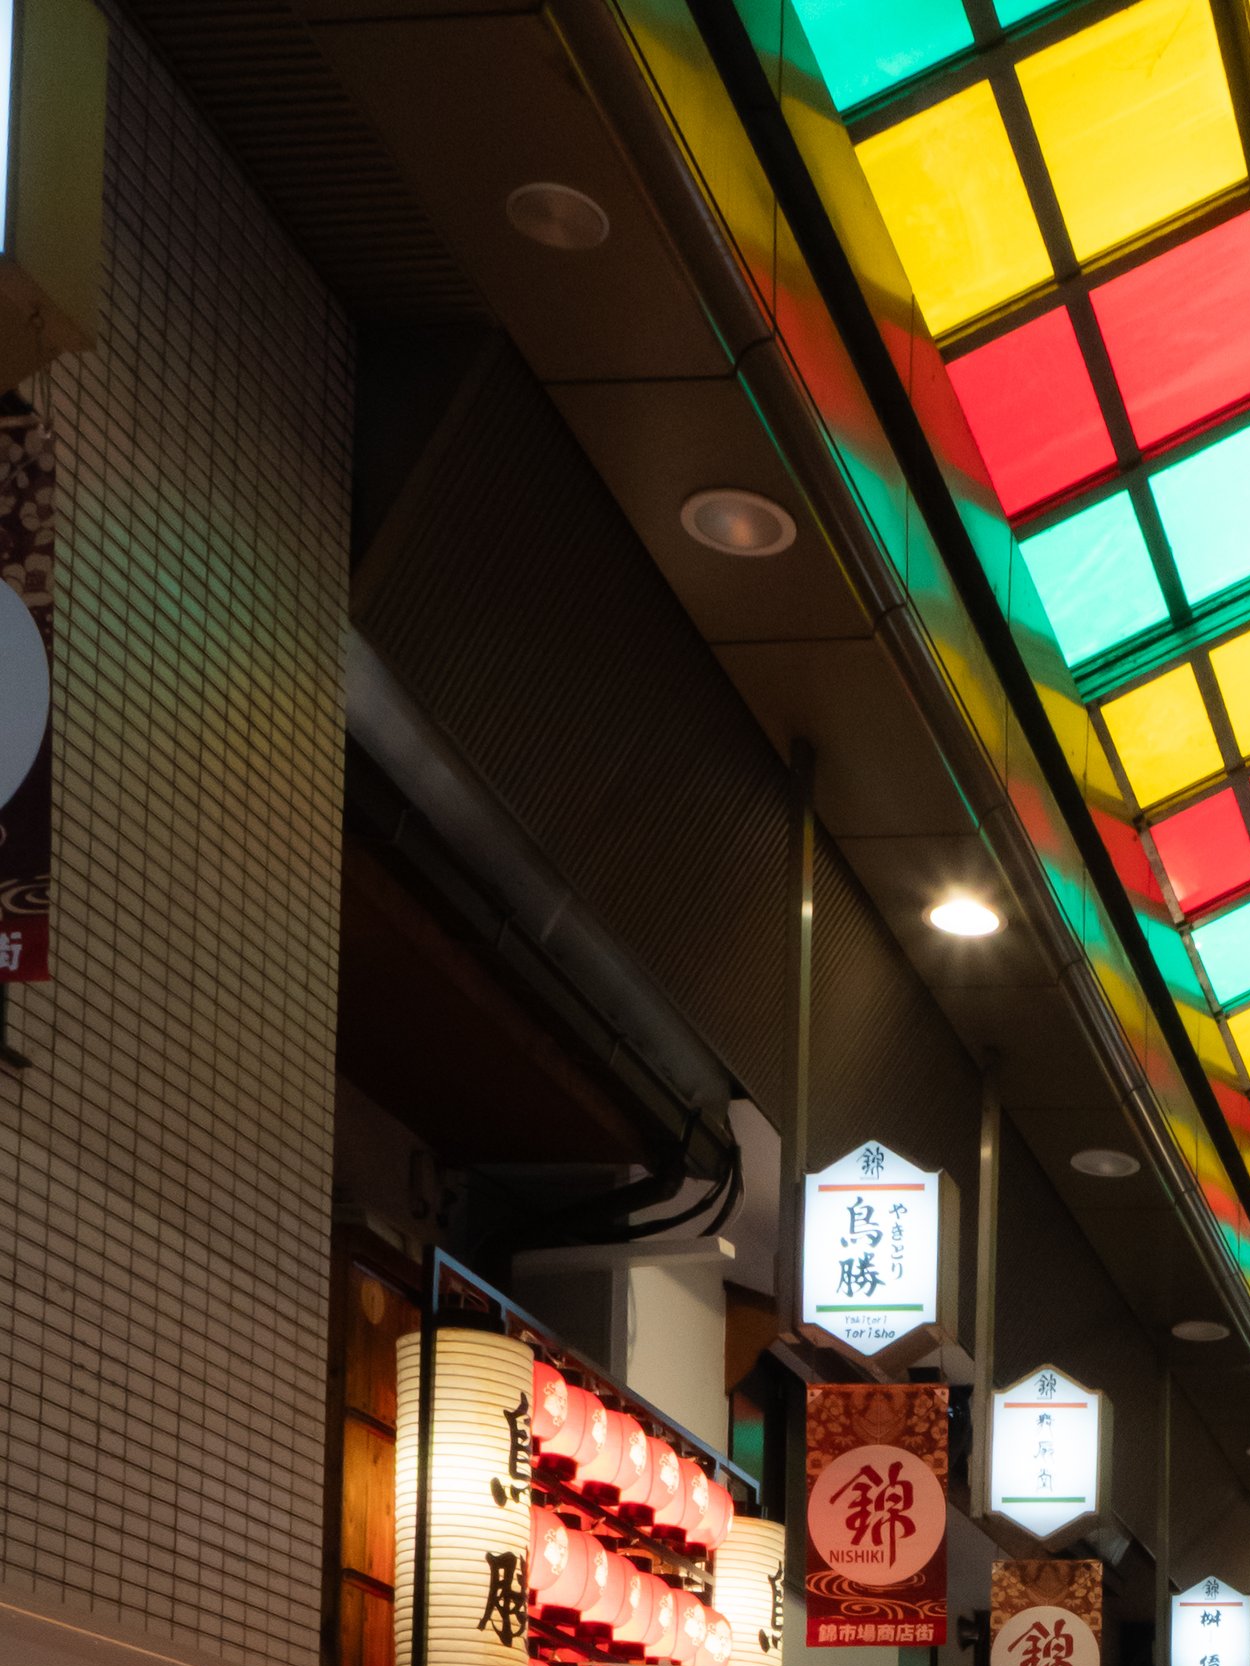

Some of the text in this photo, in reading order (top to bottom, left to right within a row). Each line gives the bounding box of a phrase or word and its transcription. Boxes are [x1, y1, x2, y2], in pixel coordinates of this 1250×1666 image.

[856, 1146, 884, 1180] 錦
[835, 1195, 886, 1298] 鳥勝
[889, 1202, 908, 1280] やきとり
[845, 1326, 895, 1339] Torisho
[1034, 1374, 1056, 1399] 錦
[829, 1461, 916, 1569] 錦
[829, 1549, 885, 1564] NISHIKI
[818, 1622, 935, 1643] 錦市場商店街
